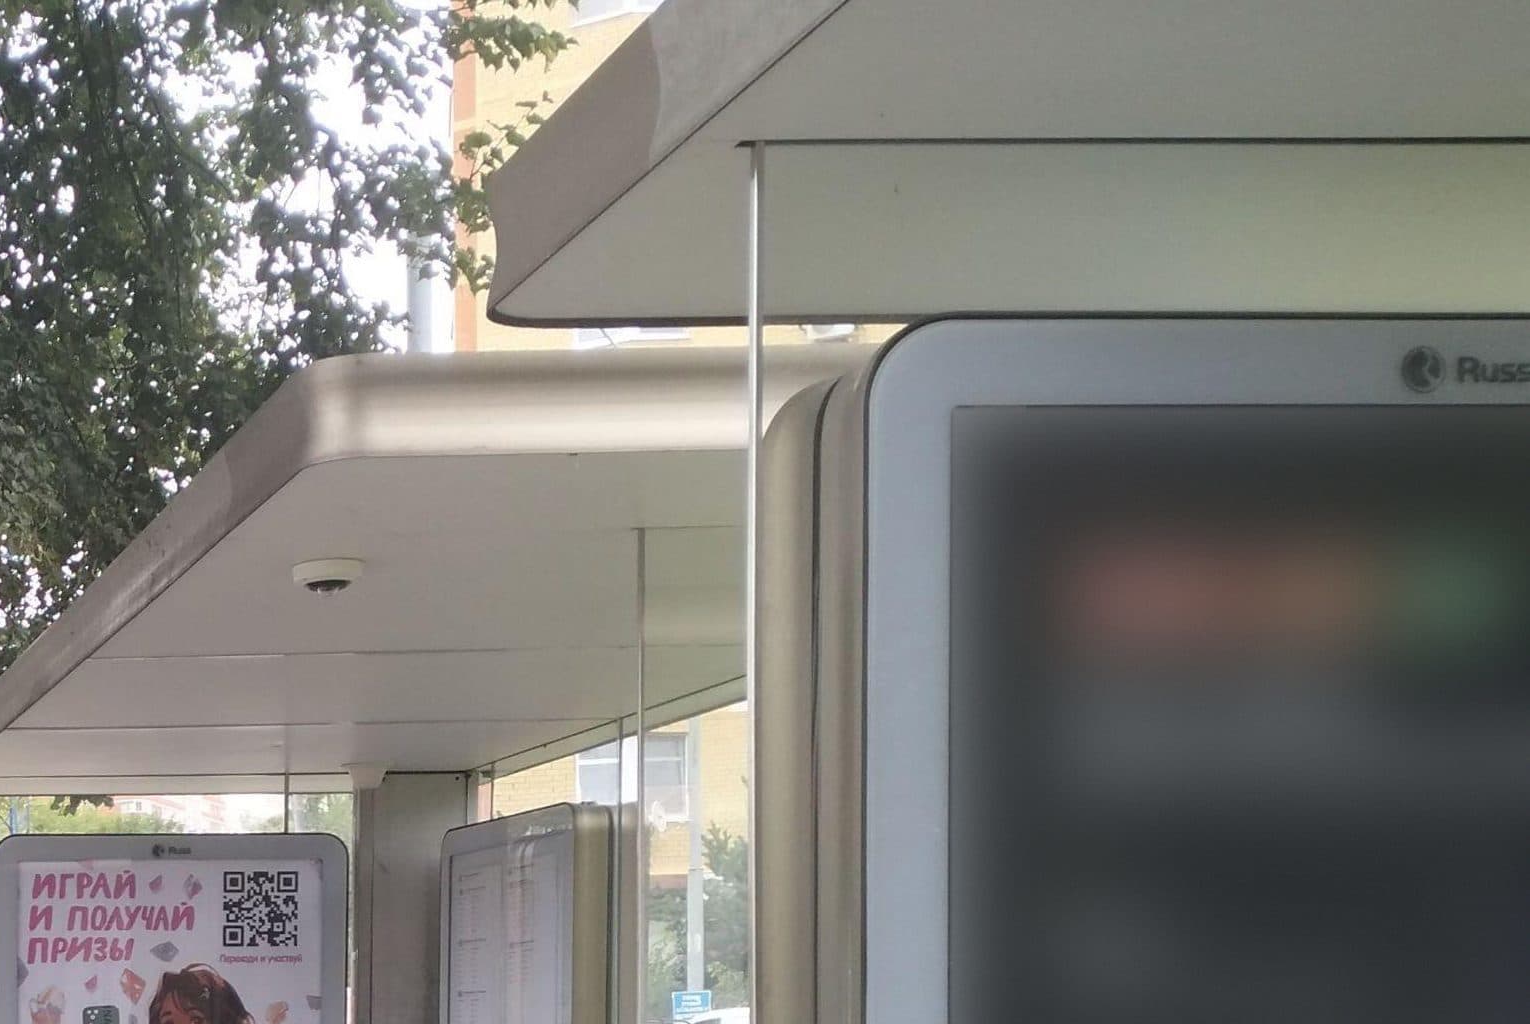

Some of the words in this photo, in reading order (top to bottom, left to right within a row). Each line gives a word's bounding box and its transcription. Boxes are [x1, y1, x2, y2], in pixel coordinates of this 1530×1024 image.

[32, 870, 136, 899] ИГРАЙ
[29, 905, 53, 931] И
[67, 902, 195, 931] ПОЛУЧАЙ
[27, 937, 135, 964] ПРИЗЫ
